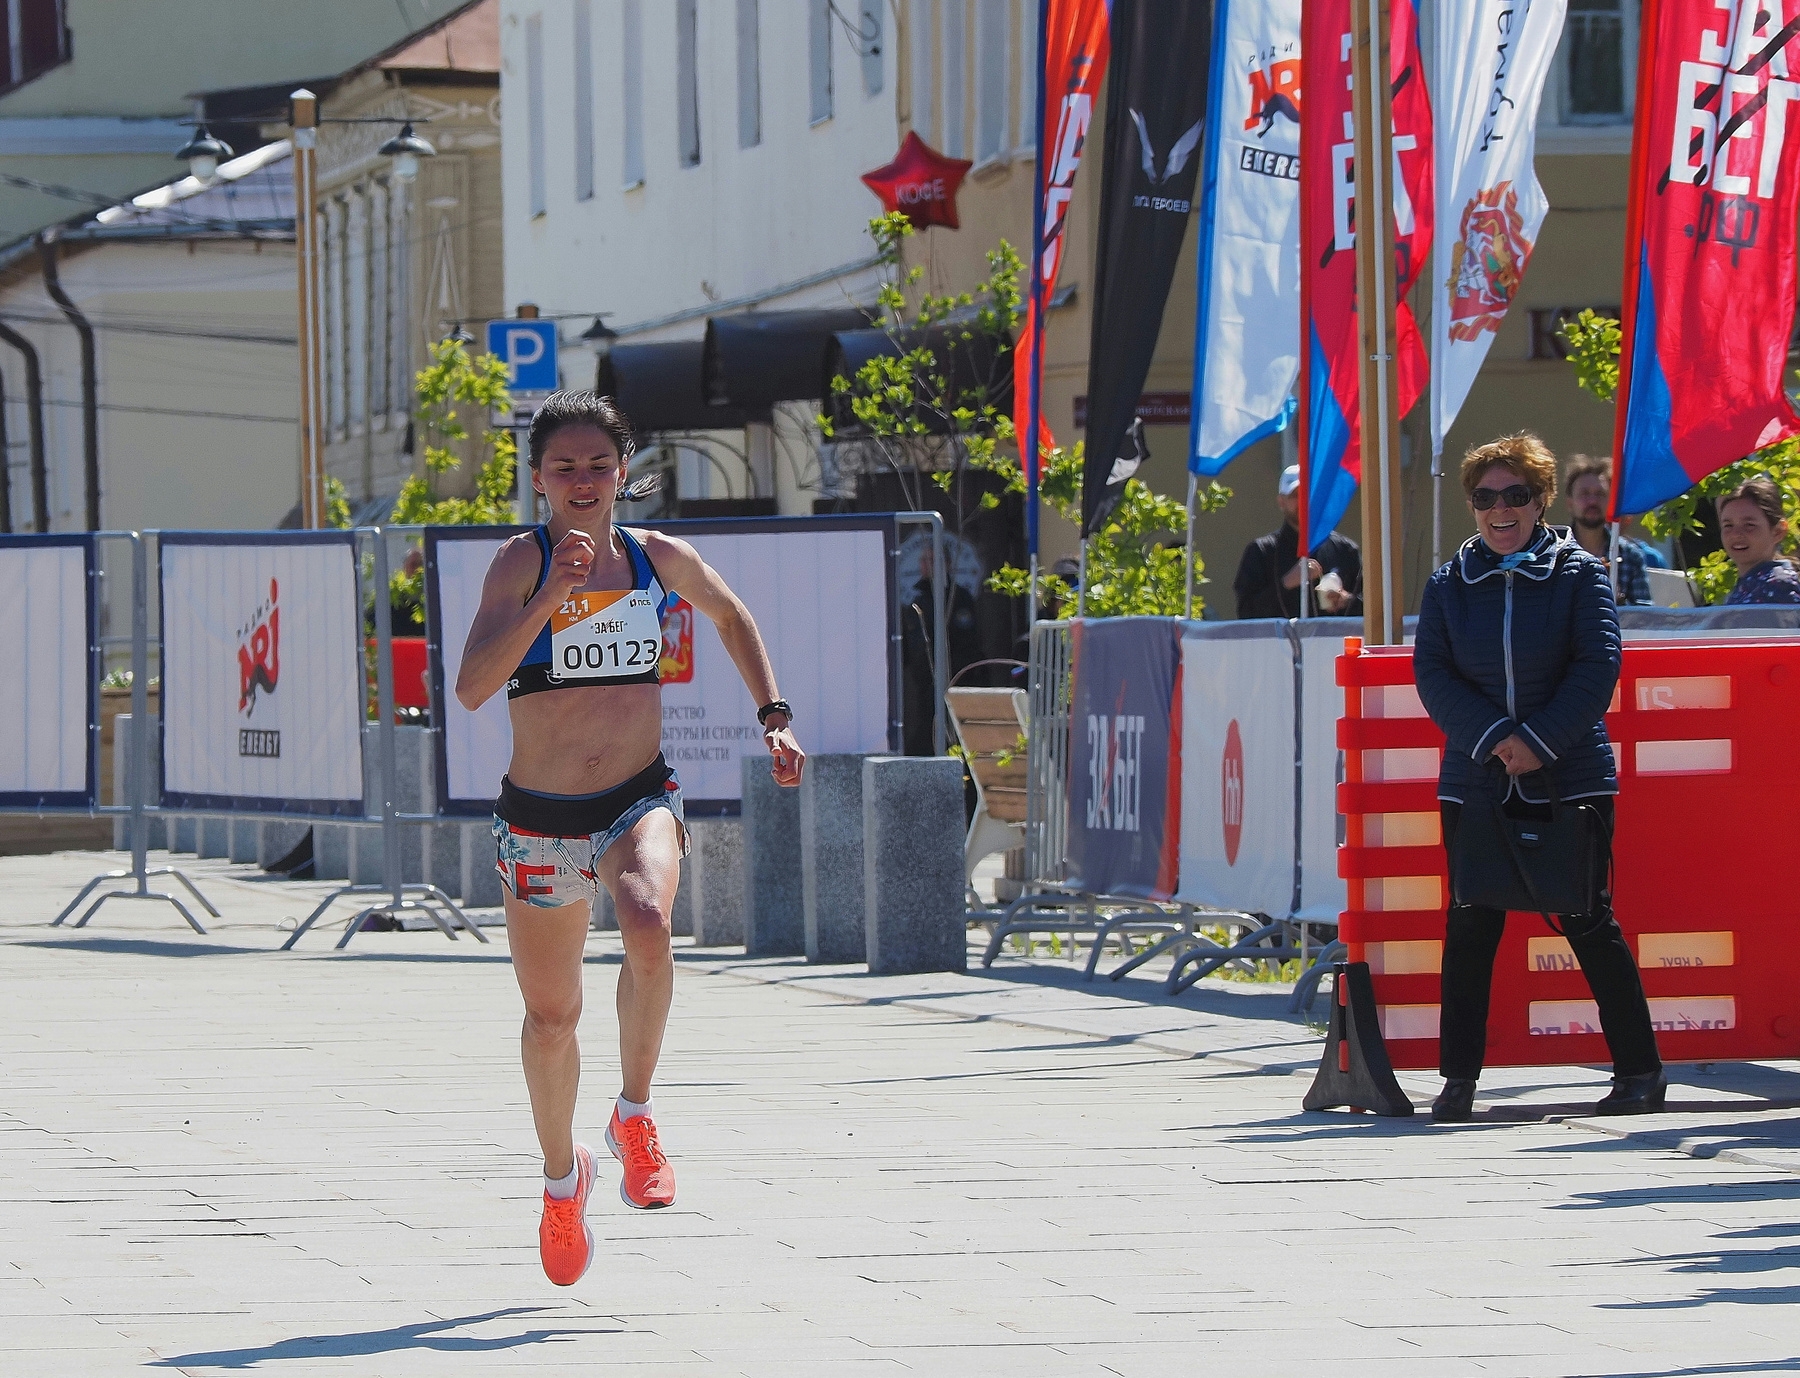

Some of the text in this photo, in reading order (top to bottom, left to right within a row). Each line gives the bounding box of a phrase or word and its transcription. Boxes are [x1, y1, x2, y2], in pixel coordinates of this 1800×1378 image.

[1244, 58, 1300, 131] NR
[1669, 61, 1800, 199] БЕГ
[1242, 148, 1300, 178] ENERG
[559, 598, 589, 615] 21,1
[563, 639, 659, 670] 00123
[662, 705, 706, 720] ЕРСТВО
[662, 727, 698, 740] ЬТУРЫ
[712, 726, 757, 740] СПОРТА
